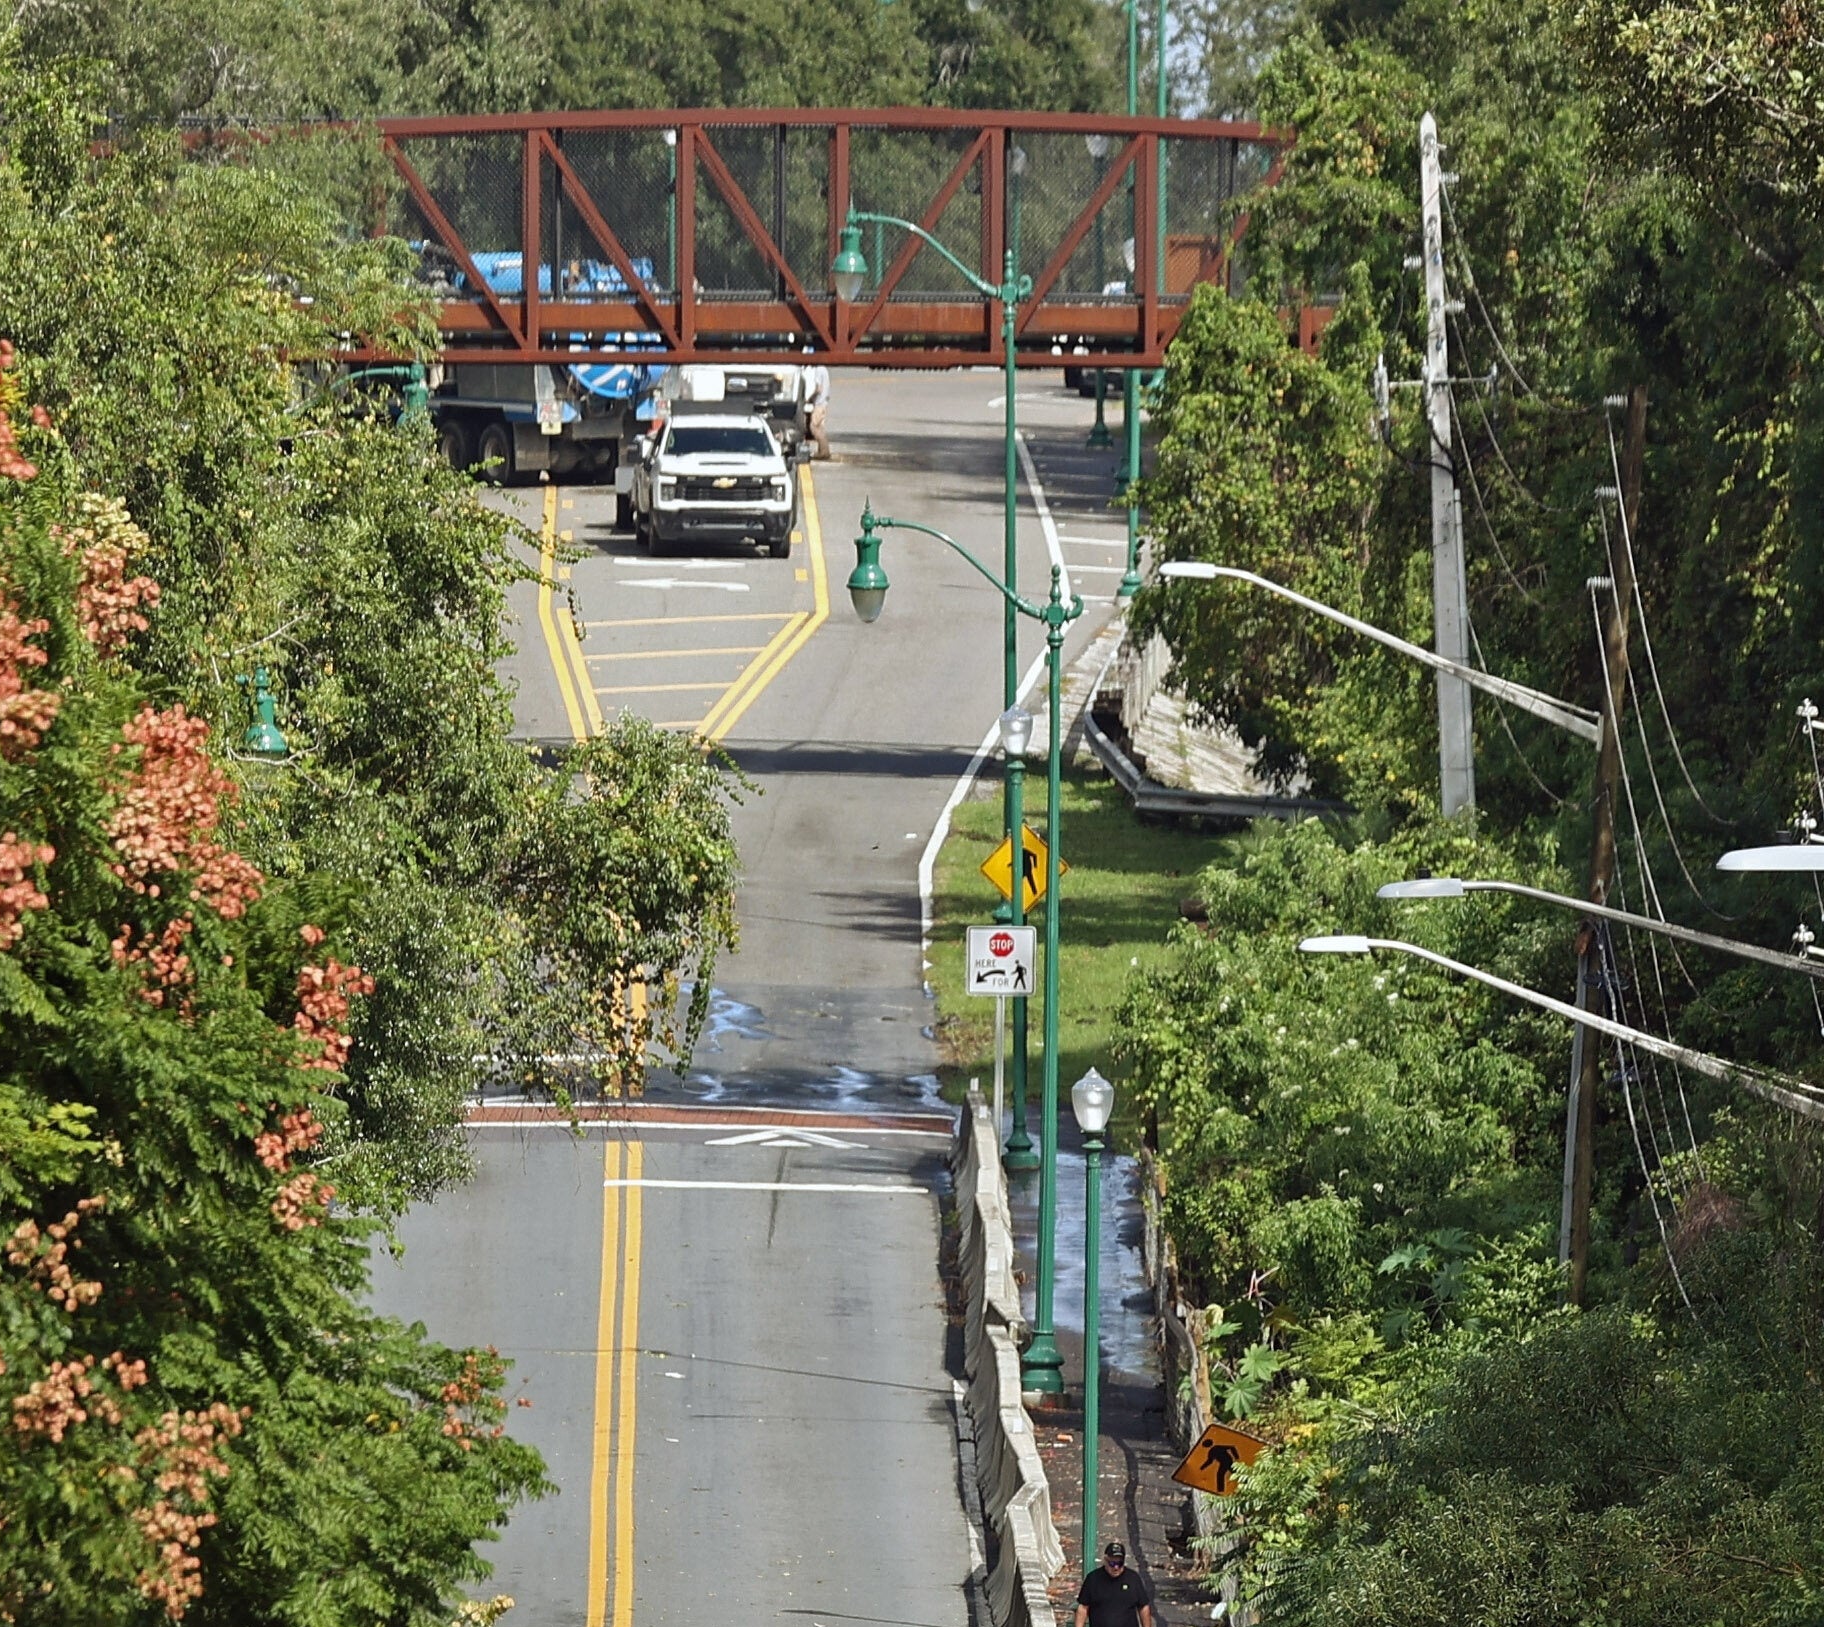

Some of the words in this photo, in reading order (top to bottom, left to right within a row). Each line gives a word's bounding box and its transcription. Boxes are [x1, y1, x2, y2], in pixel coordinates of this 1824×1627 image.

[990, 939, 1013, 950] STOP
[975, 958, 996, 968] HERE
[992, 977, 1009, 987] FOR
